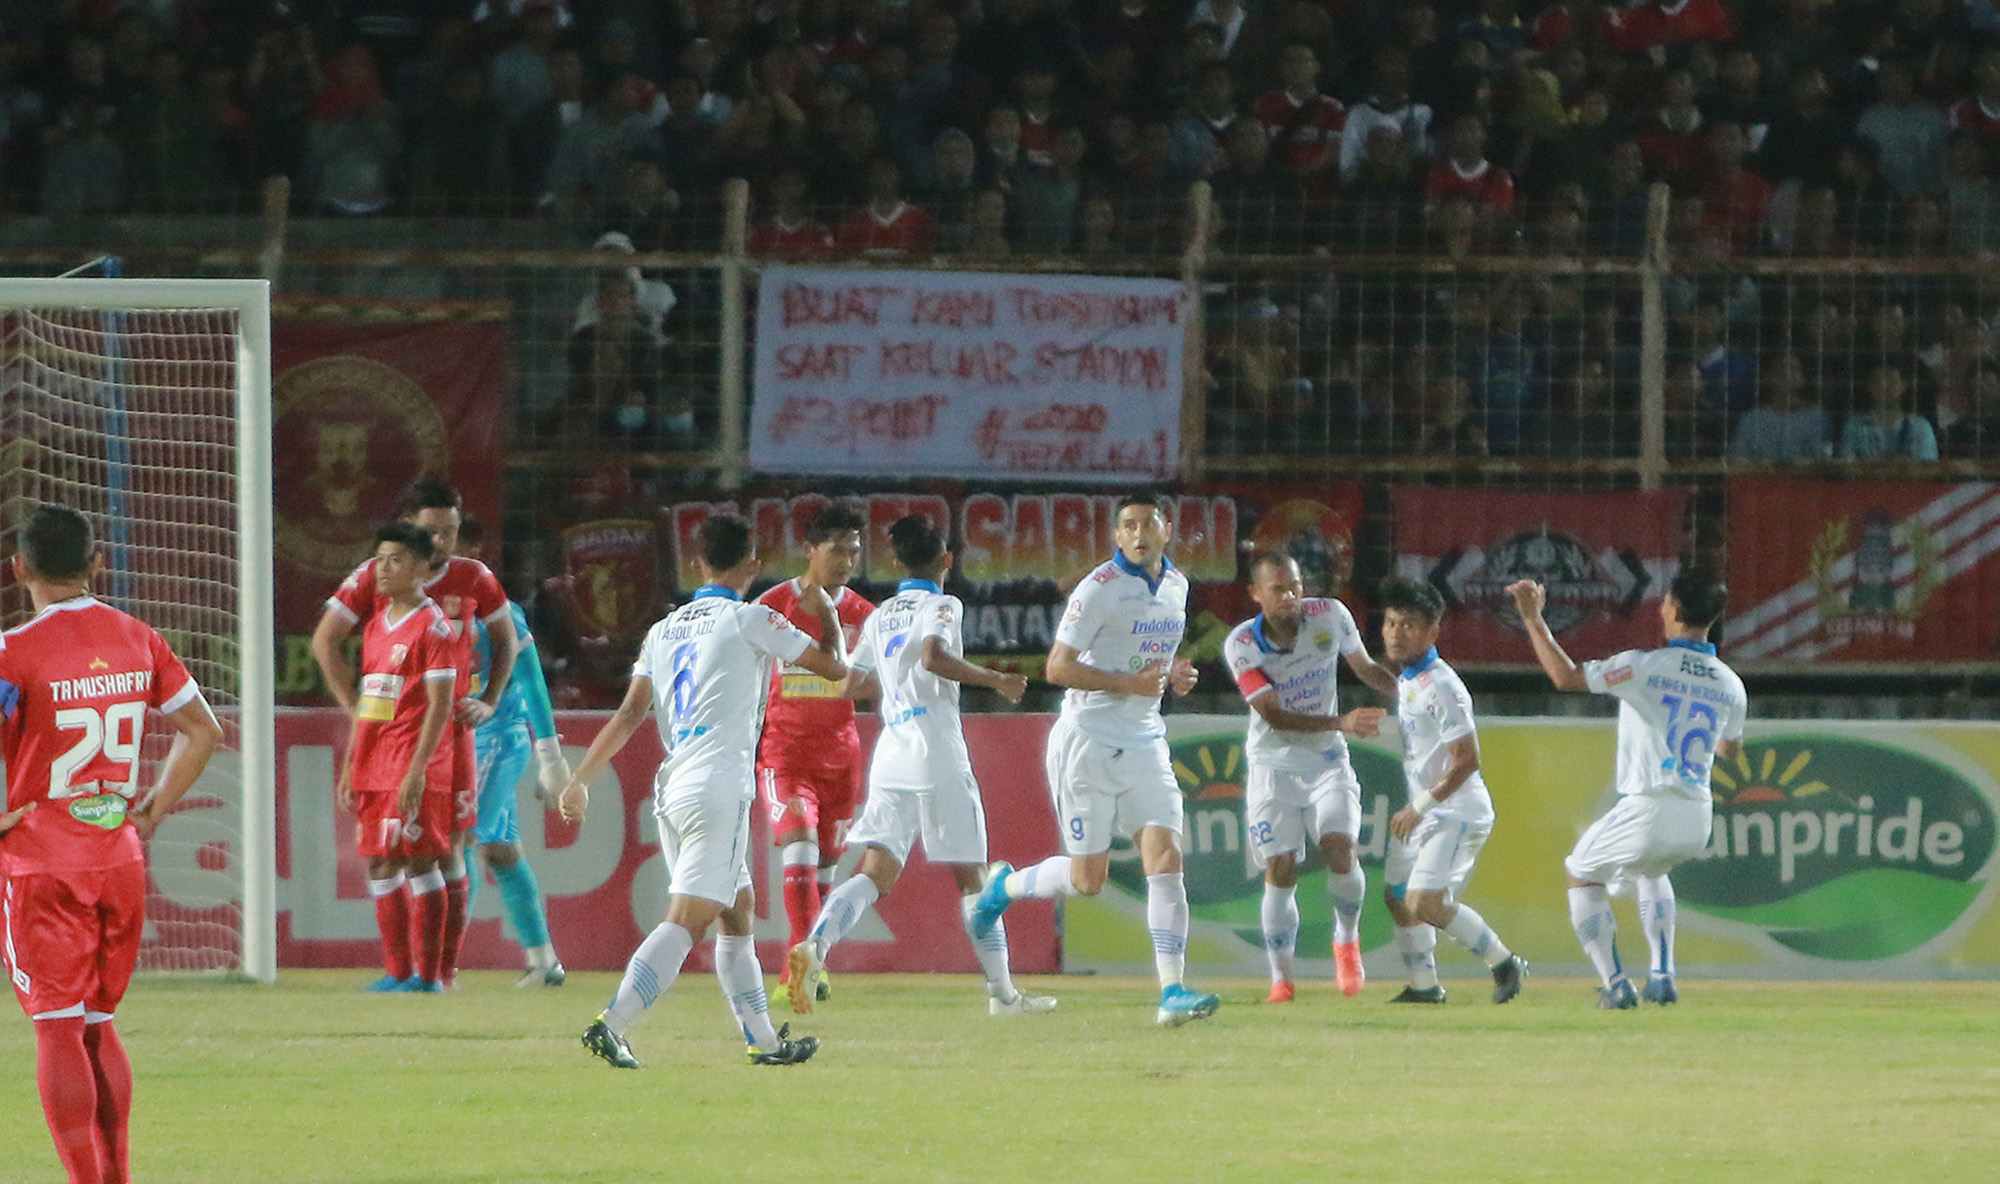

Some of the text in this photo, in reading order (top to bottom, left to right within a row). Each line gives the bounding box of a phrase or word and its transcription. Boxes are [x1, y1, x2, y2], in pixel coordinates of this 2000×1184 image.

[781, 283, 900, 328] BUAT
[662, 624, 692, 641] ABDUL
[1680, 659, 1720, 680] ABC
[48, 701, 147, 799] 29
[1662, 694, 1719, 778] 12
[74, 801, 126, 818] Sunpride
[1069, 816, 1085, 841] 9
[1692, 795, 1965, 884] unpride
